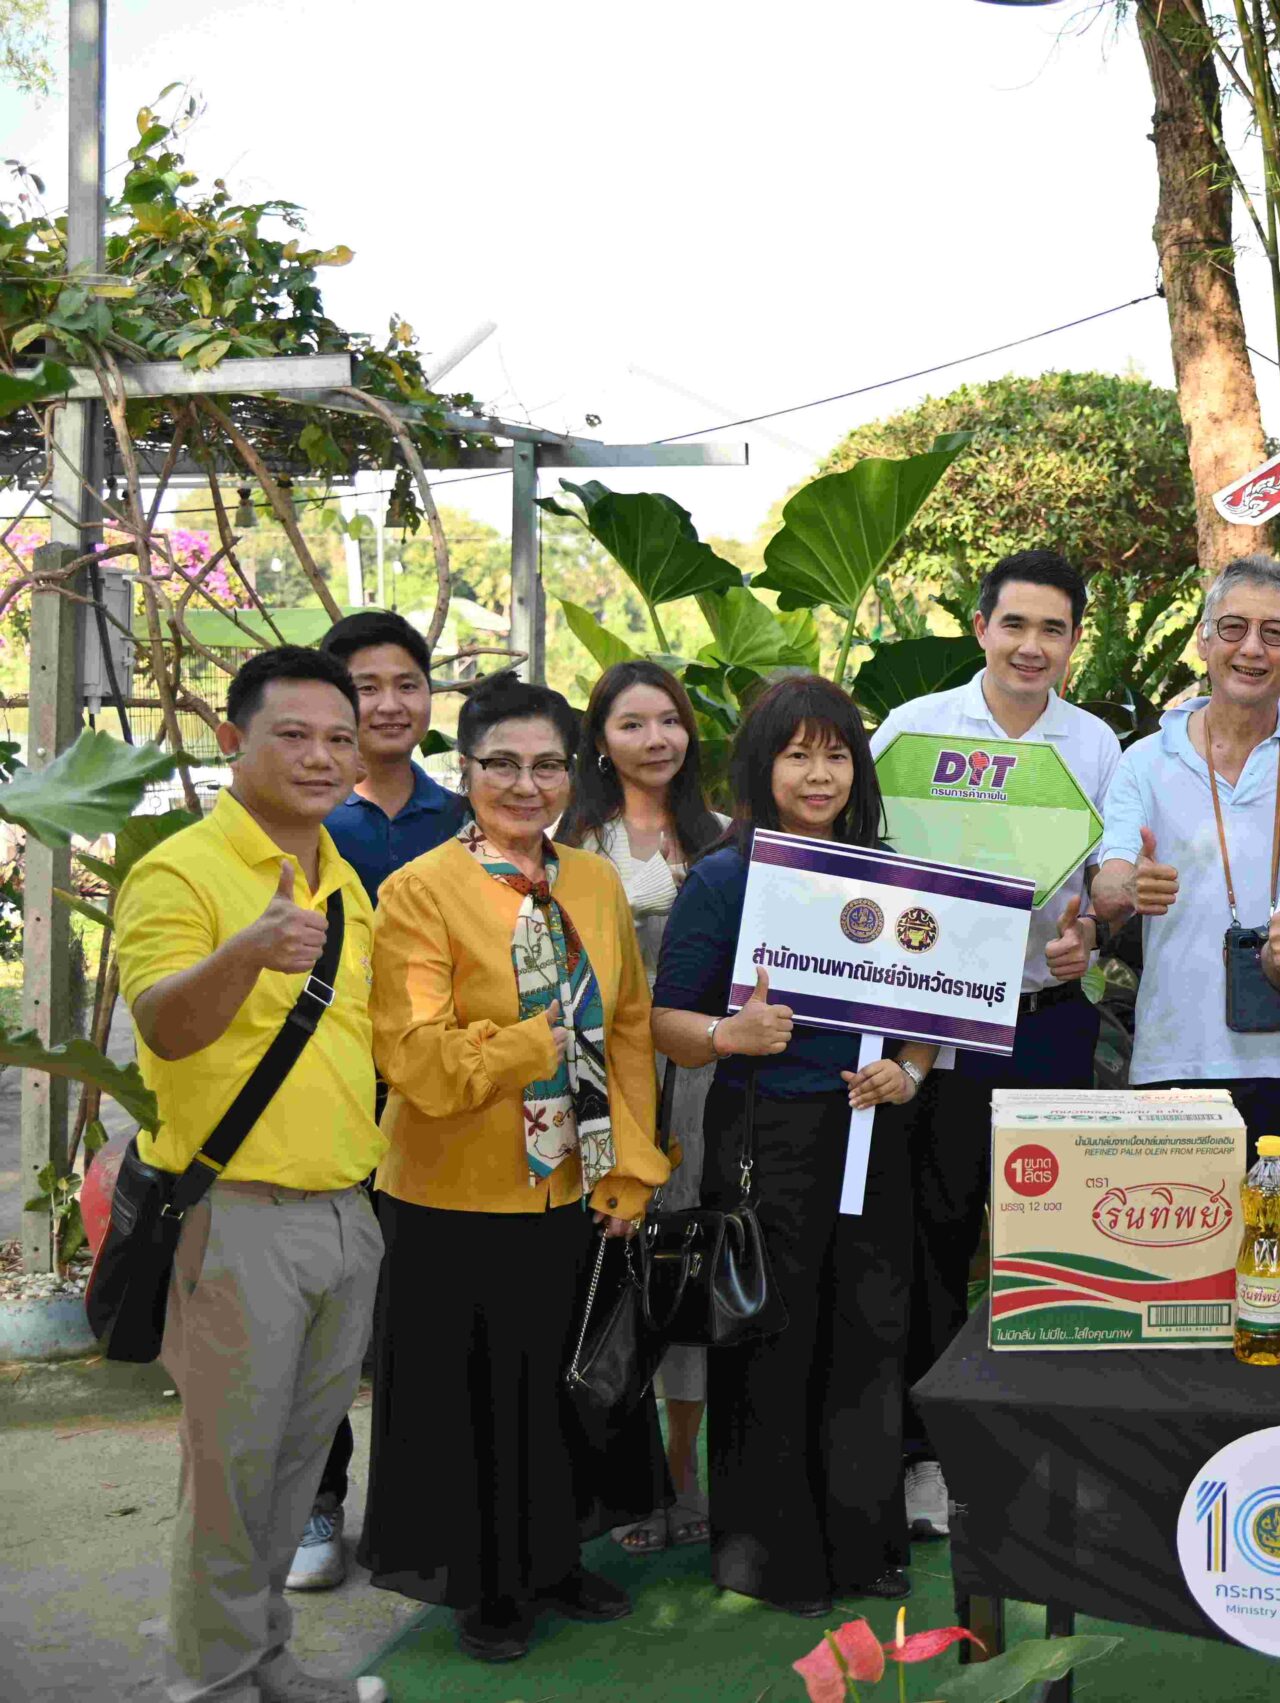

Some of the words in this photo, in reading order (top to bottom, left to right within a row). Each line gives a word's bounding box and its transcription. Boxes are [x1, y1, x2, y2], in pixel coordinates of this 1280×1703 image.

[932, 751, 1017, 788] DIT
[931, 787, 1007, 801] กรมการค้าภายใน
[752, 942, 1007, 1008] สำนักงานพาณิชย์จังหวัดราชบุรี
[1085, 1148, 1119, 1156] REFINED
[1120, 1148, 1142, 1156] PALM
[1144, 1148, 1168, 1156] OLEIN
[1170, 1147, 1193, 1155] FROM
[1196, 1147, 1235, 1155] PERICARP
[1011, 1158, 1023, 1183] 1
[1024, 1158, 1052, 1169] ขนาด
[1024, 1169, 1053, 1183] ลิตร
[1085, 1177, 1109, 1188] ตรา
[1000, 1203, 1025, 1213] บรรจุ
[1029, 1202, 1040, 1211] 12
[1043, 1202, 1062, 1211] ขวด
[1104, 1179, 1226, 1229] รินทิพย์
[1225, 1604, 1277, 1618] Ministry
